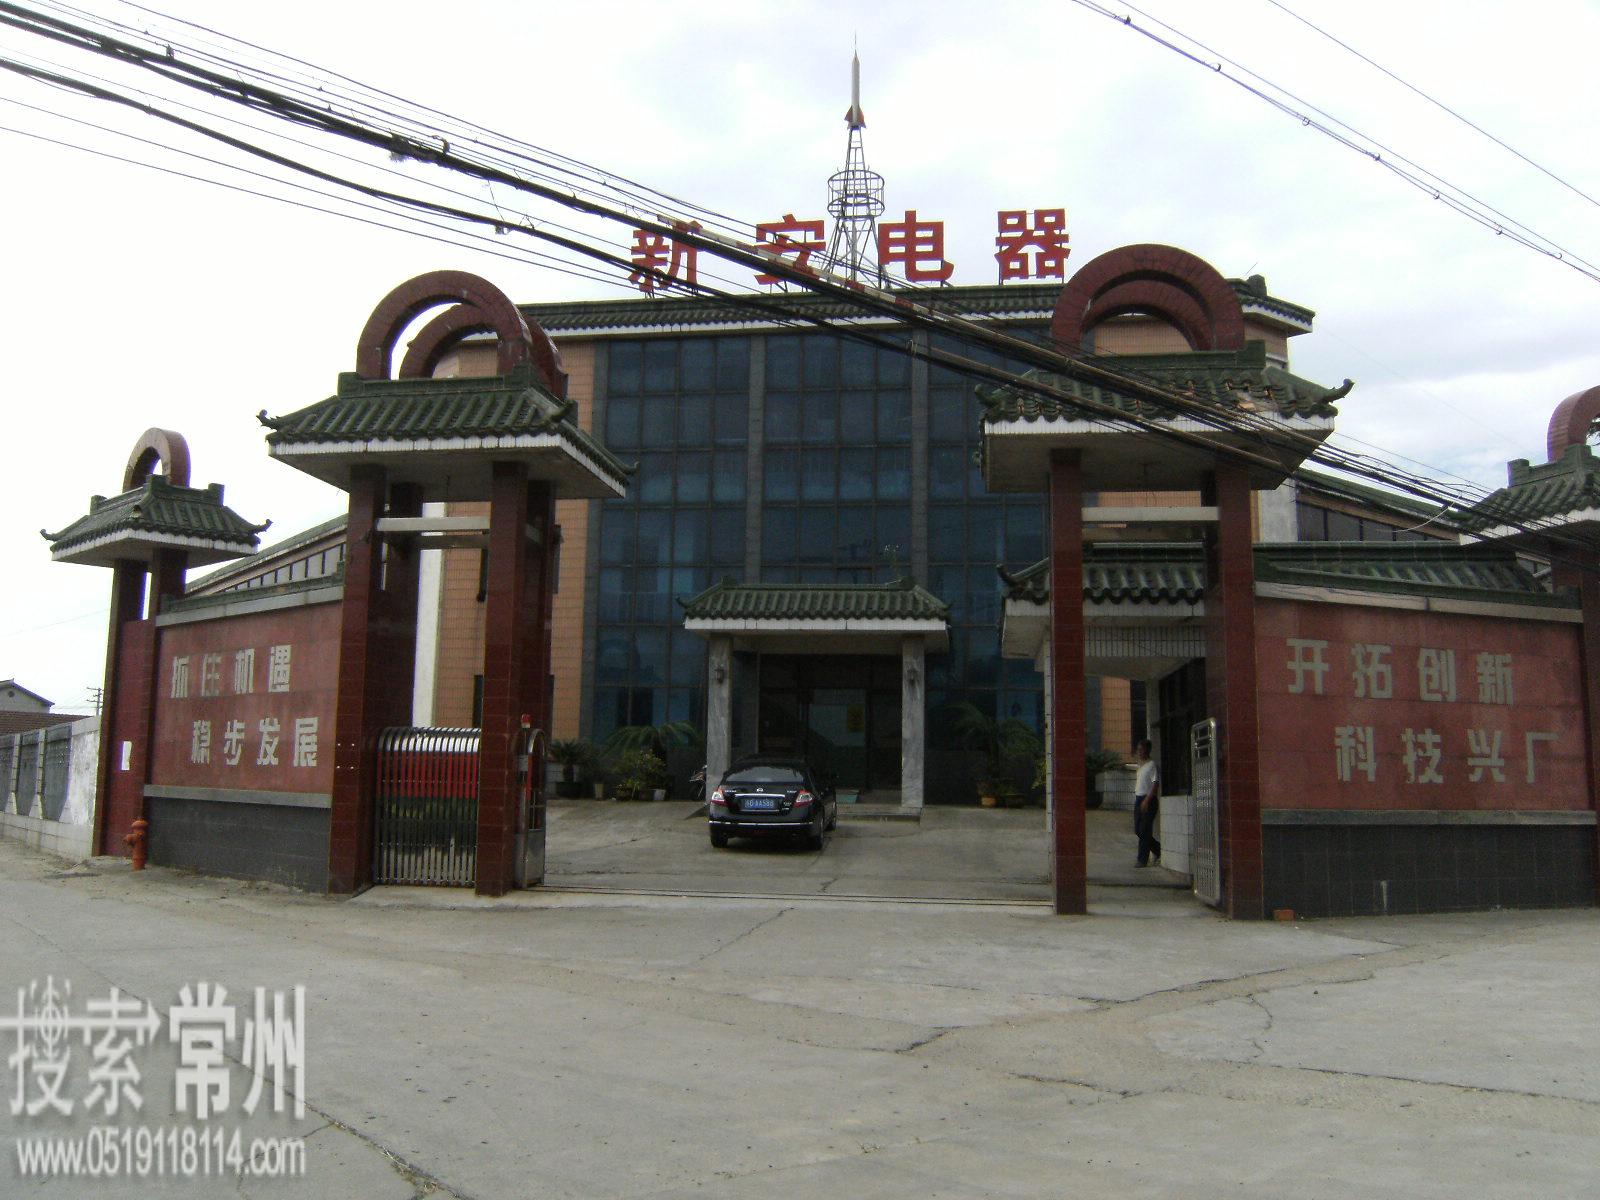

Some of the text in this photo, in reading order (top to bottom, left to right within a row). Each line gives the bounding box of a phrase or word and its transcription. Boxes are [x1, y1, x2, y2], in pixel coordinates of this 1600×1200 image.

[629, 208, 1071, 292] 新安电器
[1286, 638, 1514, 705] 开拓创新
[191, 717, 319, 767] 稳步发展
[1334, 725, 1560, 784] 科技兴厂
